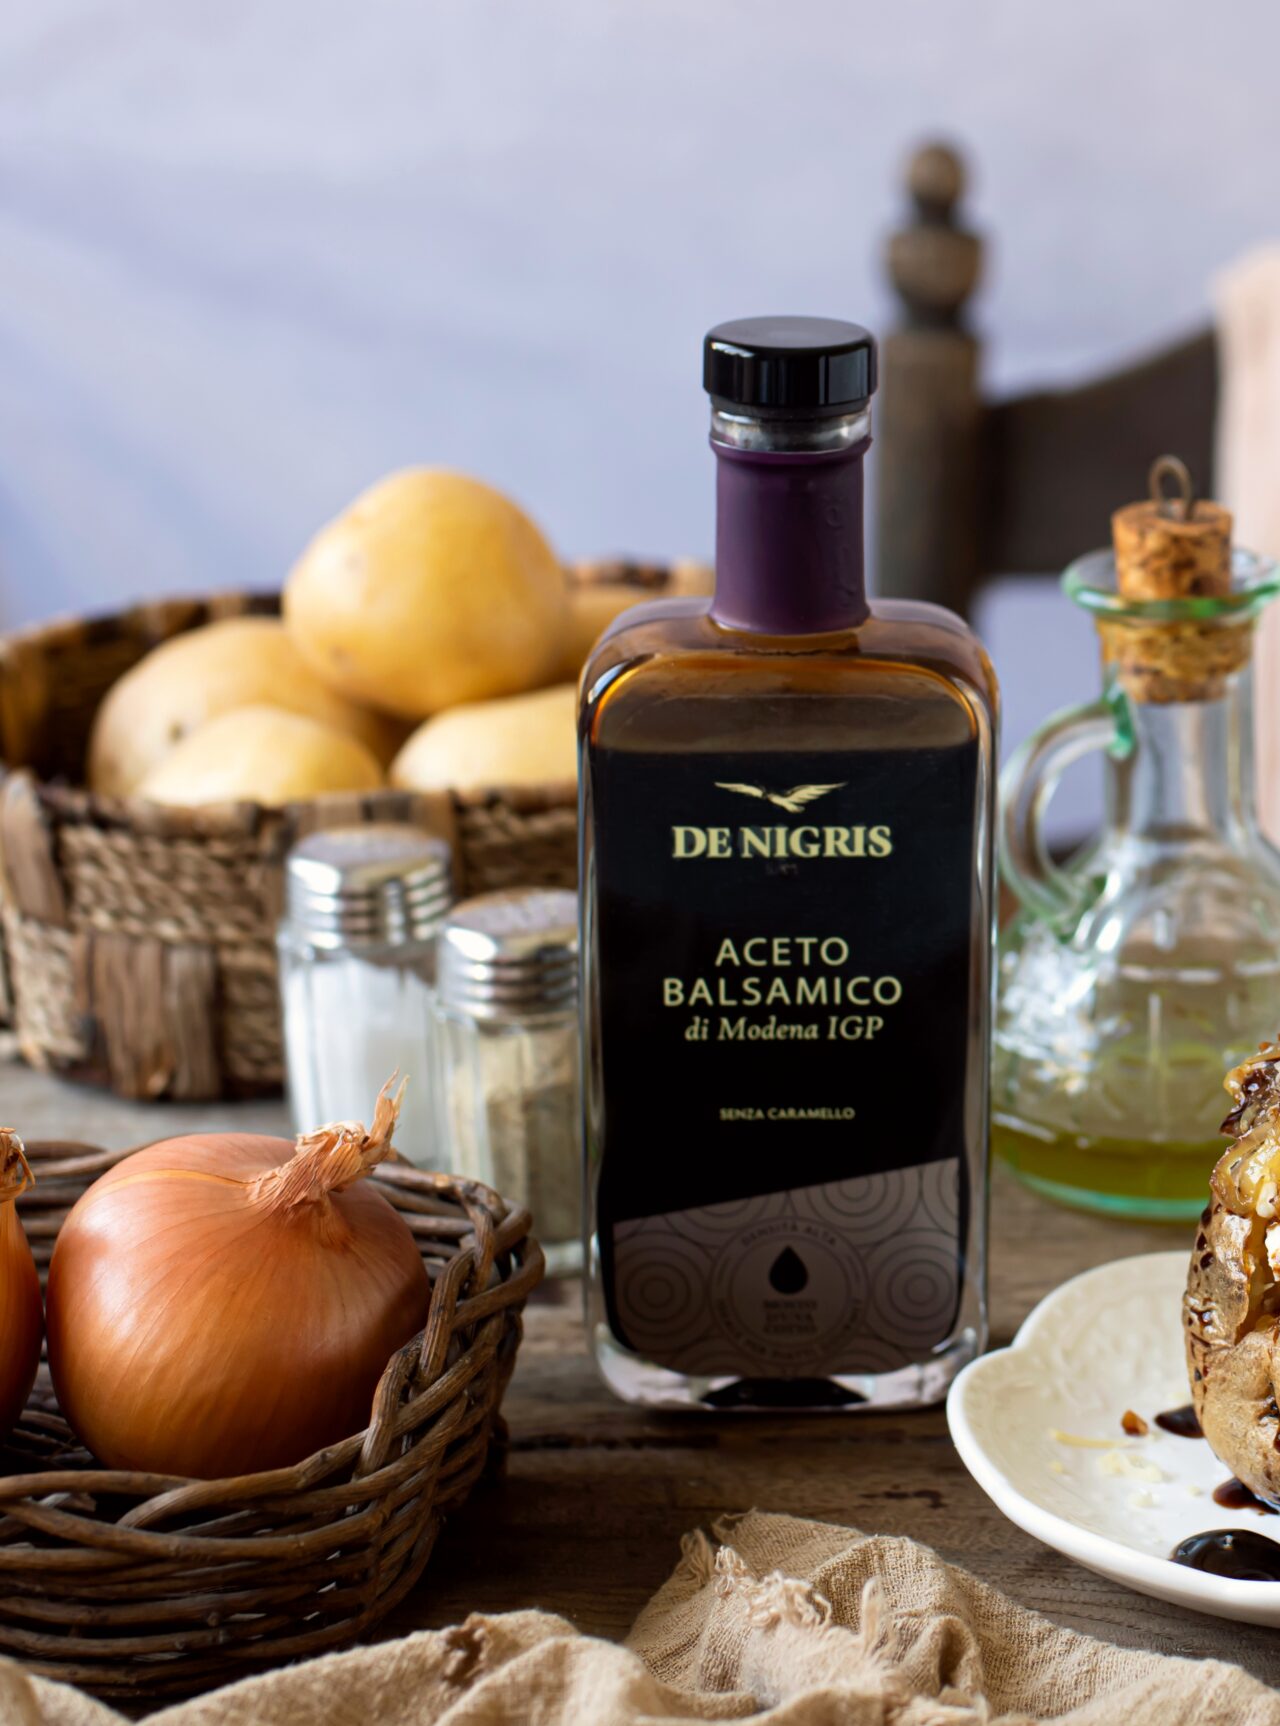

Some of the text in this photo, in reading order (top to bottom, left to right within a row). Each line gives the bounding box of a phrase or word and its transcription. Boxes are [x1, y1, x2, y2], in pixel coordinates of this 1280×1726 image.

[672, 825, 893, 858] DE NIGRIS
[715, 937, 849, 967] ACETO
[663, 976, 902, 1007] BALSAMICO
[684, 1015, 884, 1041] di Modena IGP
[720, 1107, 856, 1121] SENZA CARAMELLO
